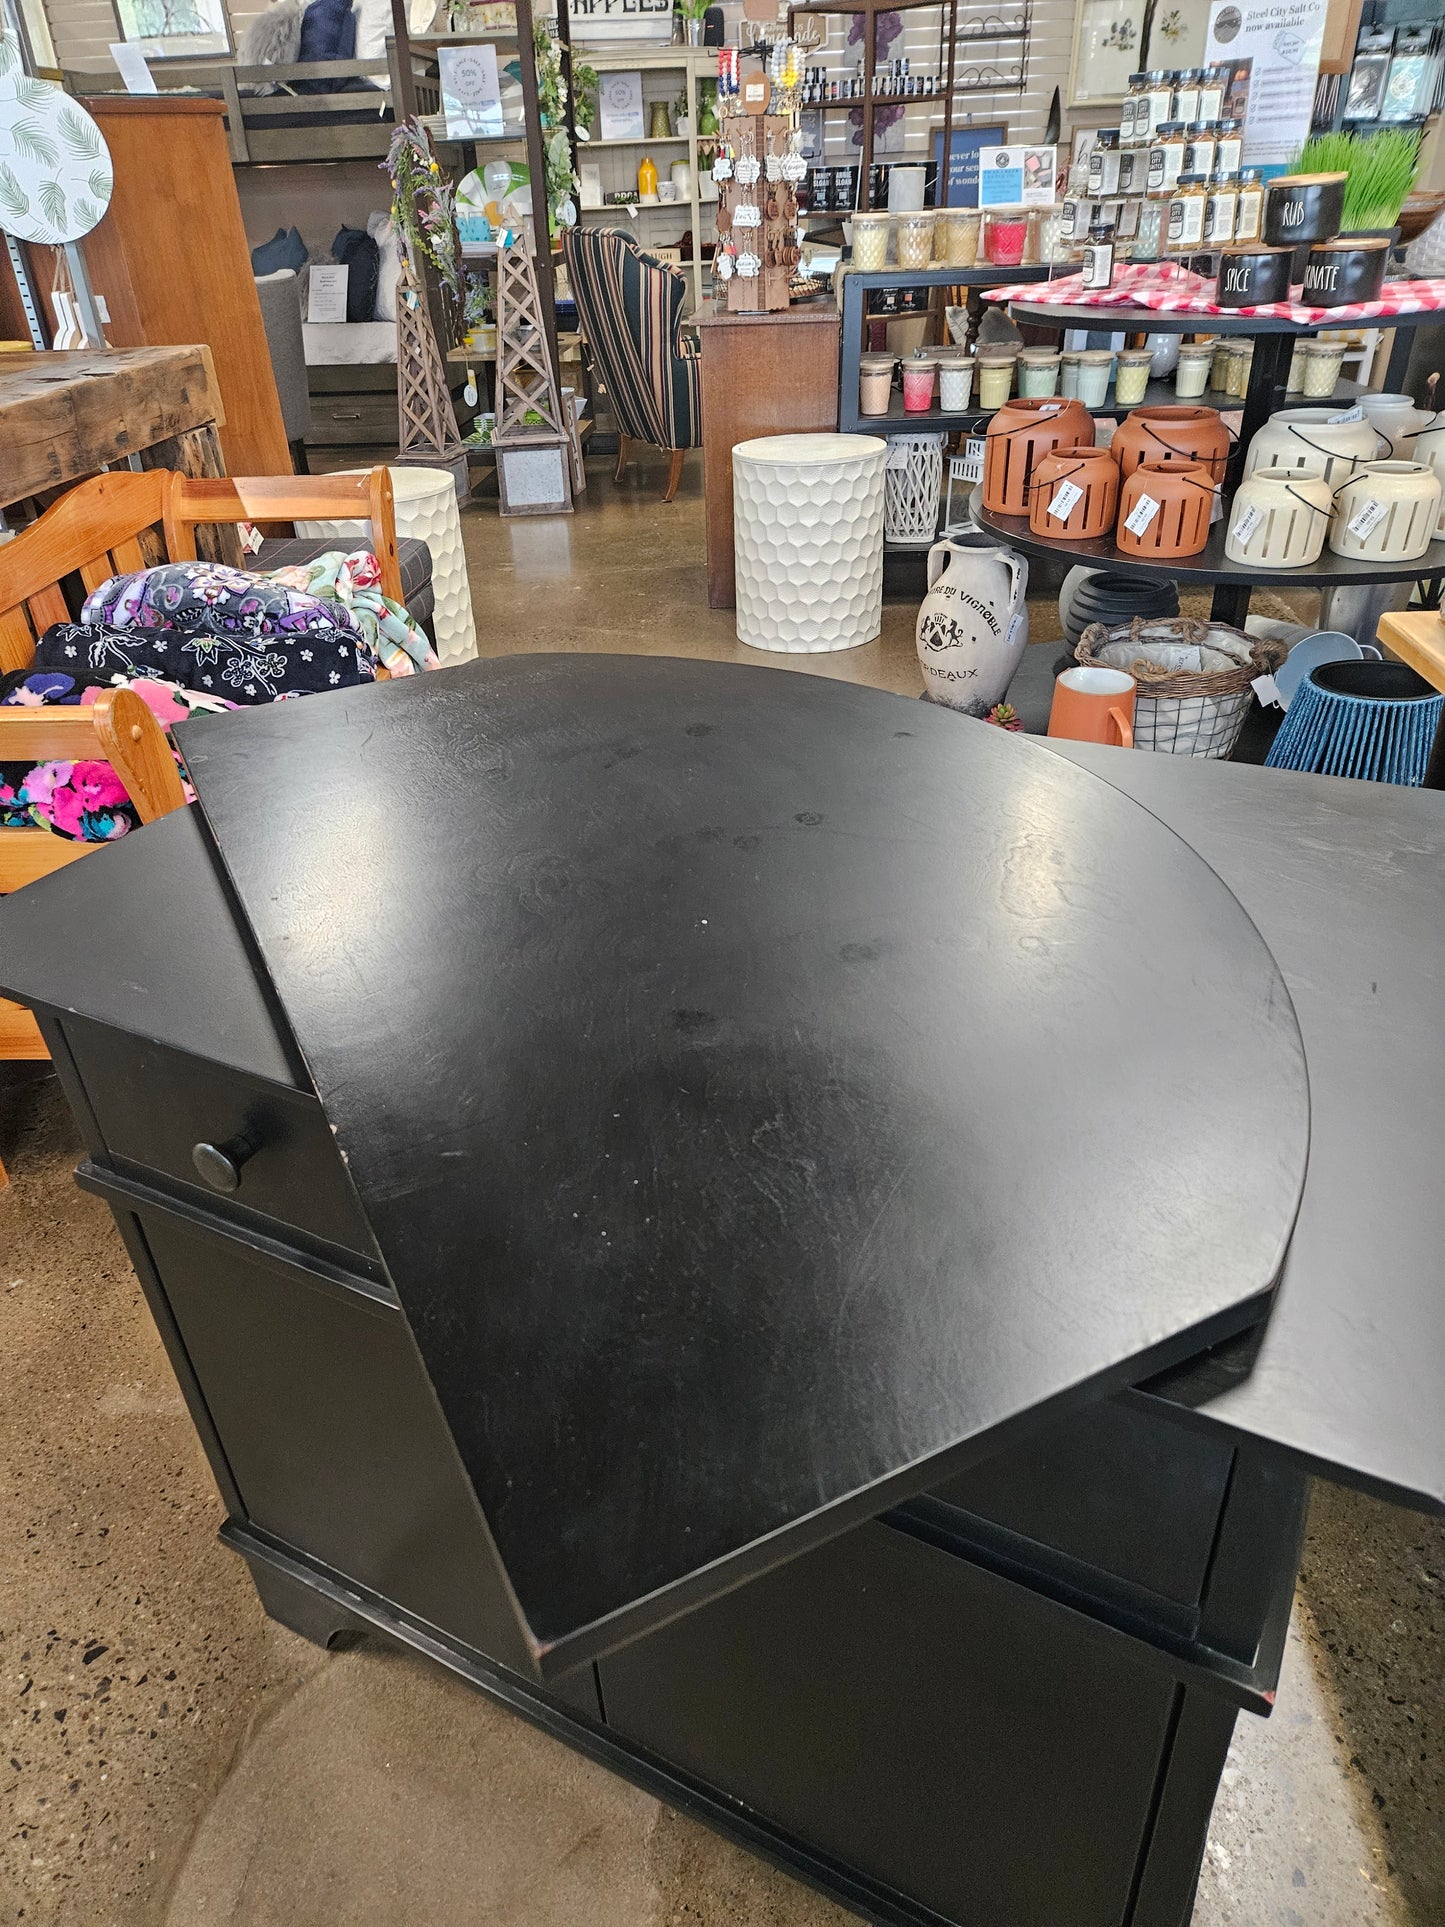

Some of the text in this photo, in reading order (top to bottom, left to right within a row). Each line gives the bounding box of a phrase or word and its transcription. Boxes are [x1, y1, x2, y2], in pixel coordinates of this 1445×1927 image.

[1246, 7, 1269, 21] Steel
[1270, 6, 1287, 18] City
[1288, 4, 1307, 15] Salt
[1308, 2, 1320, 11] Co
[1245, 16, 1305, 33] now available
[461, 69, 477, 78] 50%
[1282, 202, 1306, 226] RUB
[1225, 267, 1252, 292] SPICE
[944, 586, 957, 596] DU
